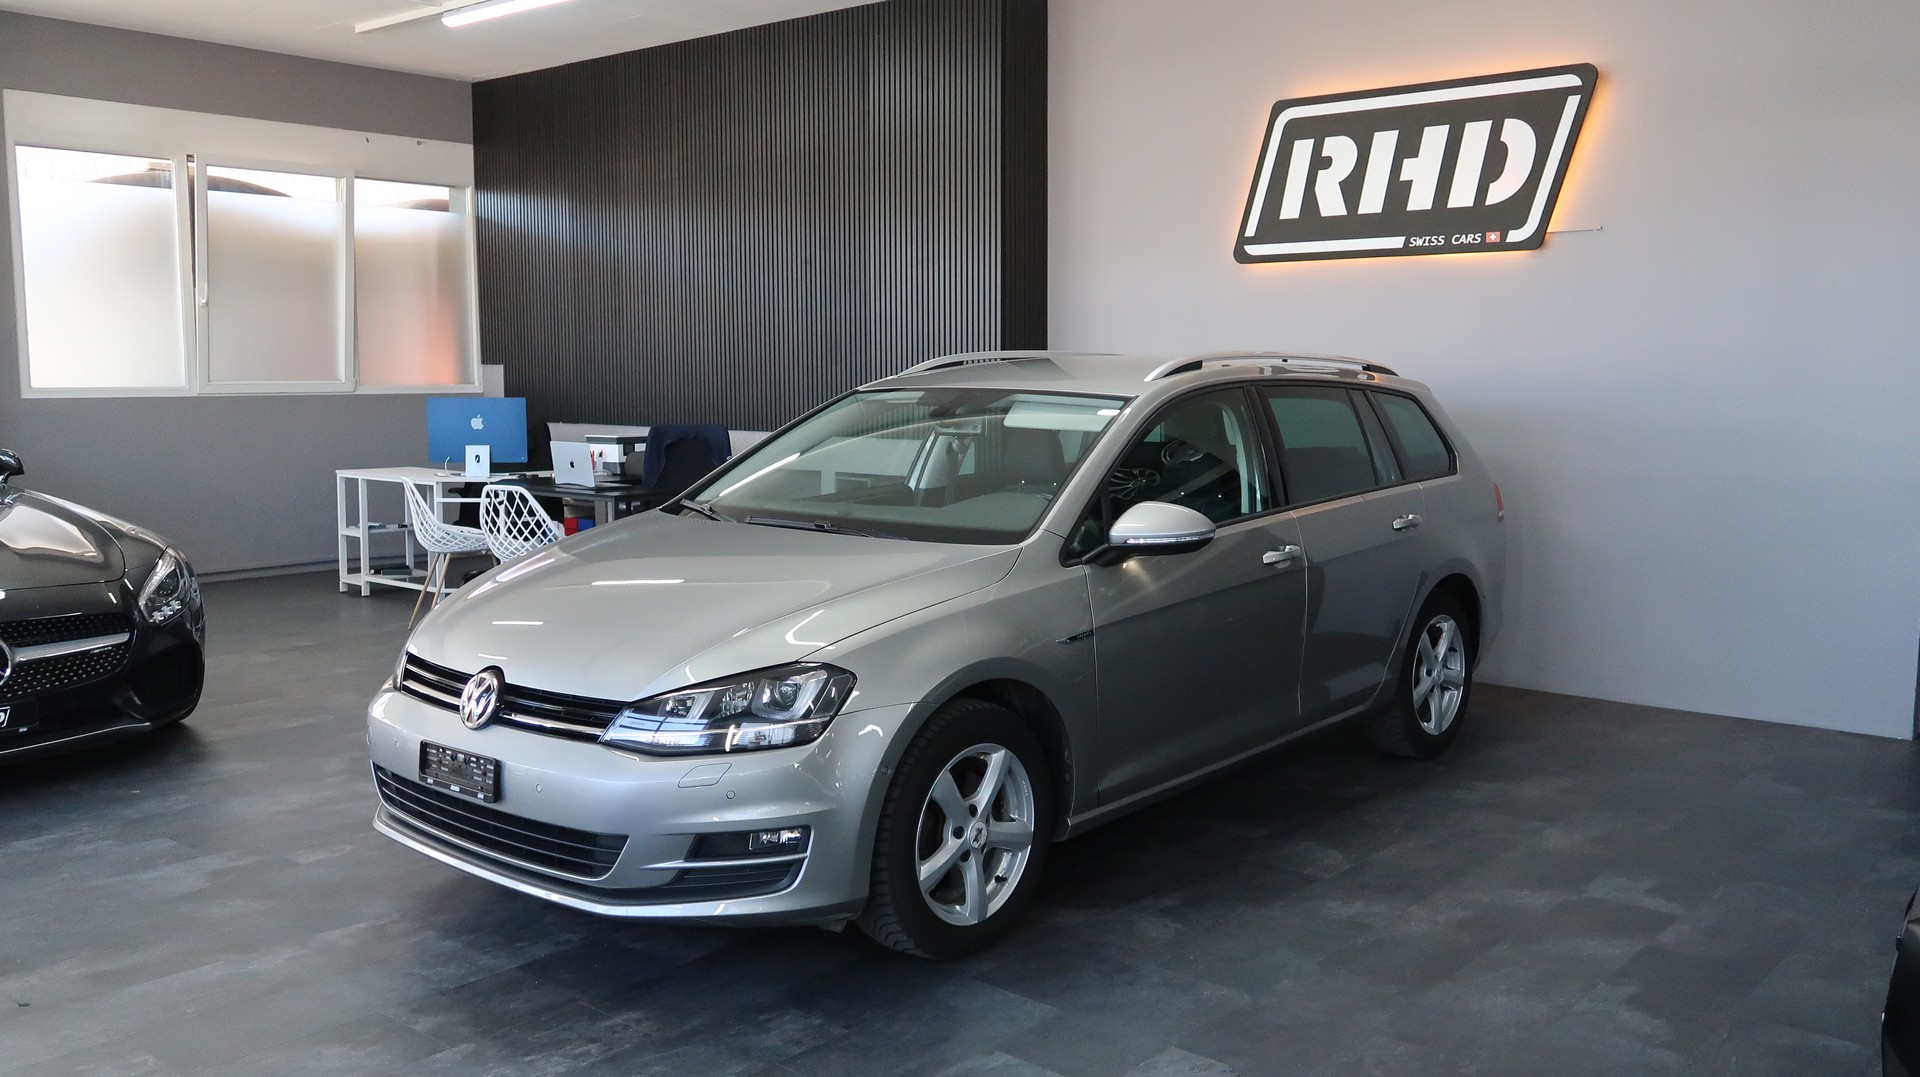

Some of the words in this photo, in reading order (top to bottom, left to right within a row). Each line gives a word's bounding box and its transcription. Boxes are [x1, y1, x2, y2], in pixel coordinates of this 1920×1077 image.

[1279, 118, 1537, 219] RHD
[1408, 235, 1446, 247] SWISS
[1451, 233, 1482, 245] CARS
